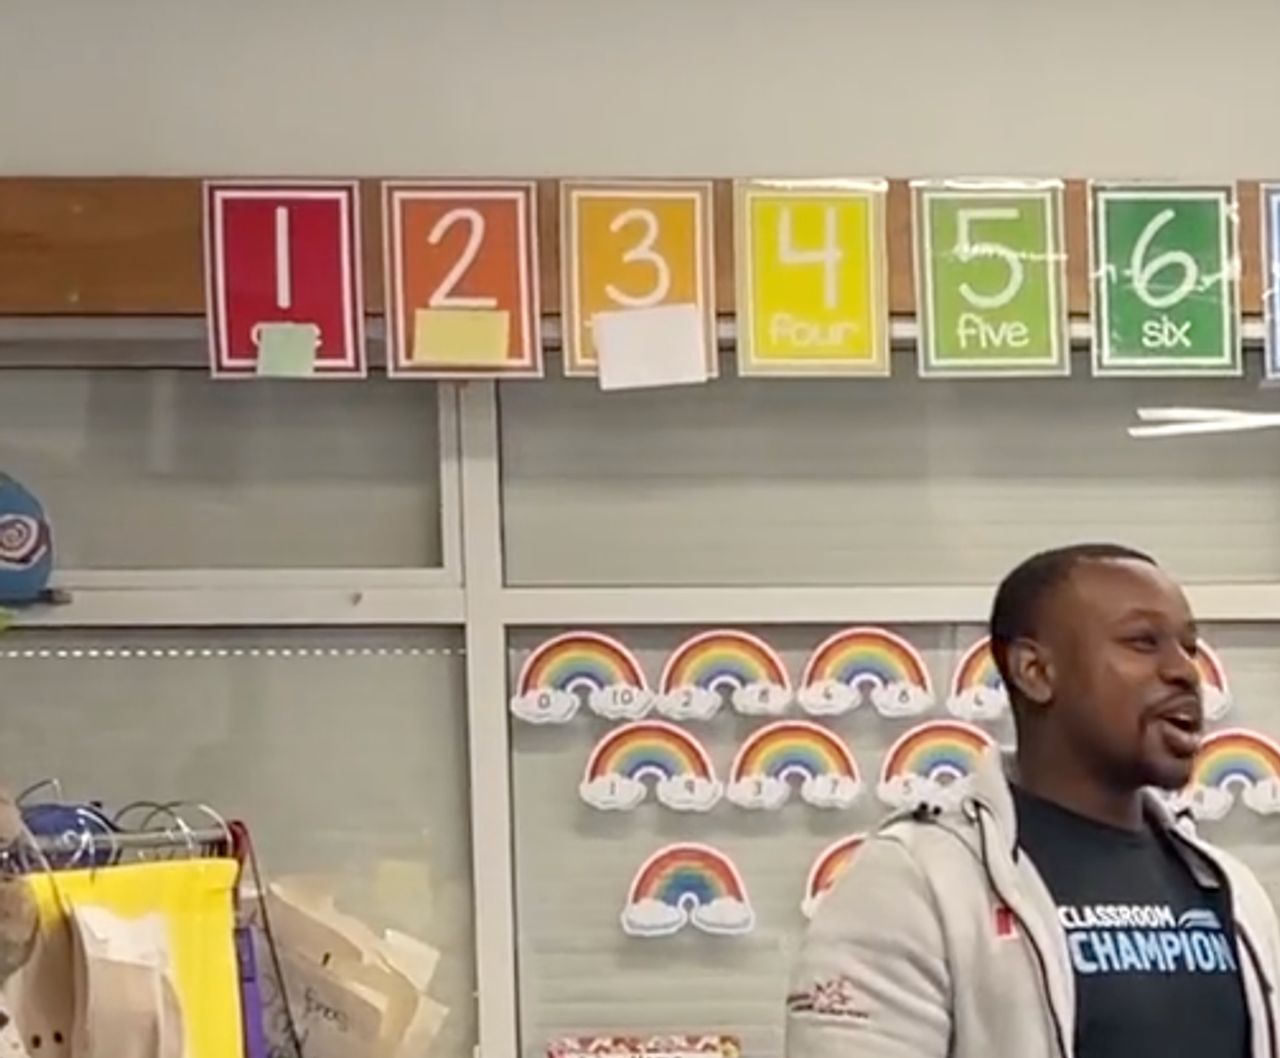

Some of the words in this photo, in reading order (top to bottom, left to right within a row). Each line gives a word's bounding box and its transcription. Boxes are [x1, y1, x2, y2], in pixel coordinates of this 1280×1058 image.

[276, 205, 291, 309] 1
[428, 208, 498, 309] 2
[605, 208, 671, 308] 3
[775, 205, 843, 310] 4
[956, 207, 1024, 309] 5
[1131, 208, 1199, 308] 6
[768, 313, 859, 347] four
[956, 313, 1030, 349] five
[1142, 315, 1192, 348] six
[1057, 904, 1176, 929] CLASSROOM
[1068, 930, 1237, 974] CHAMPION
